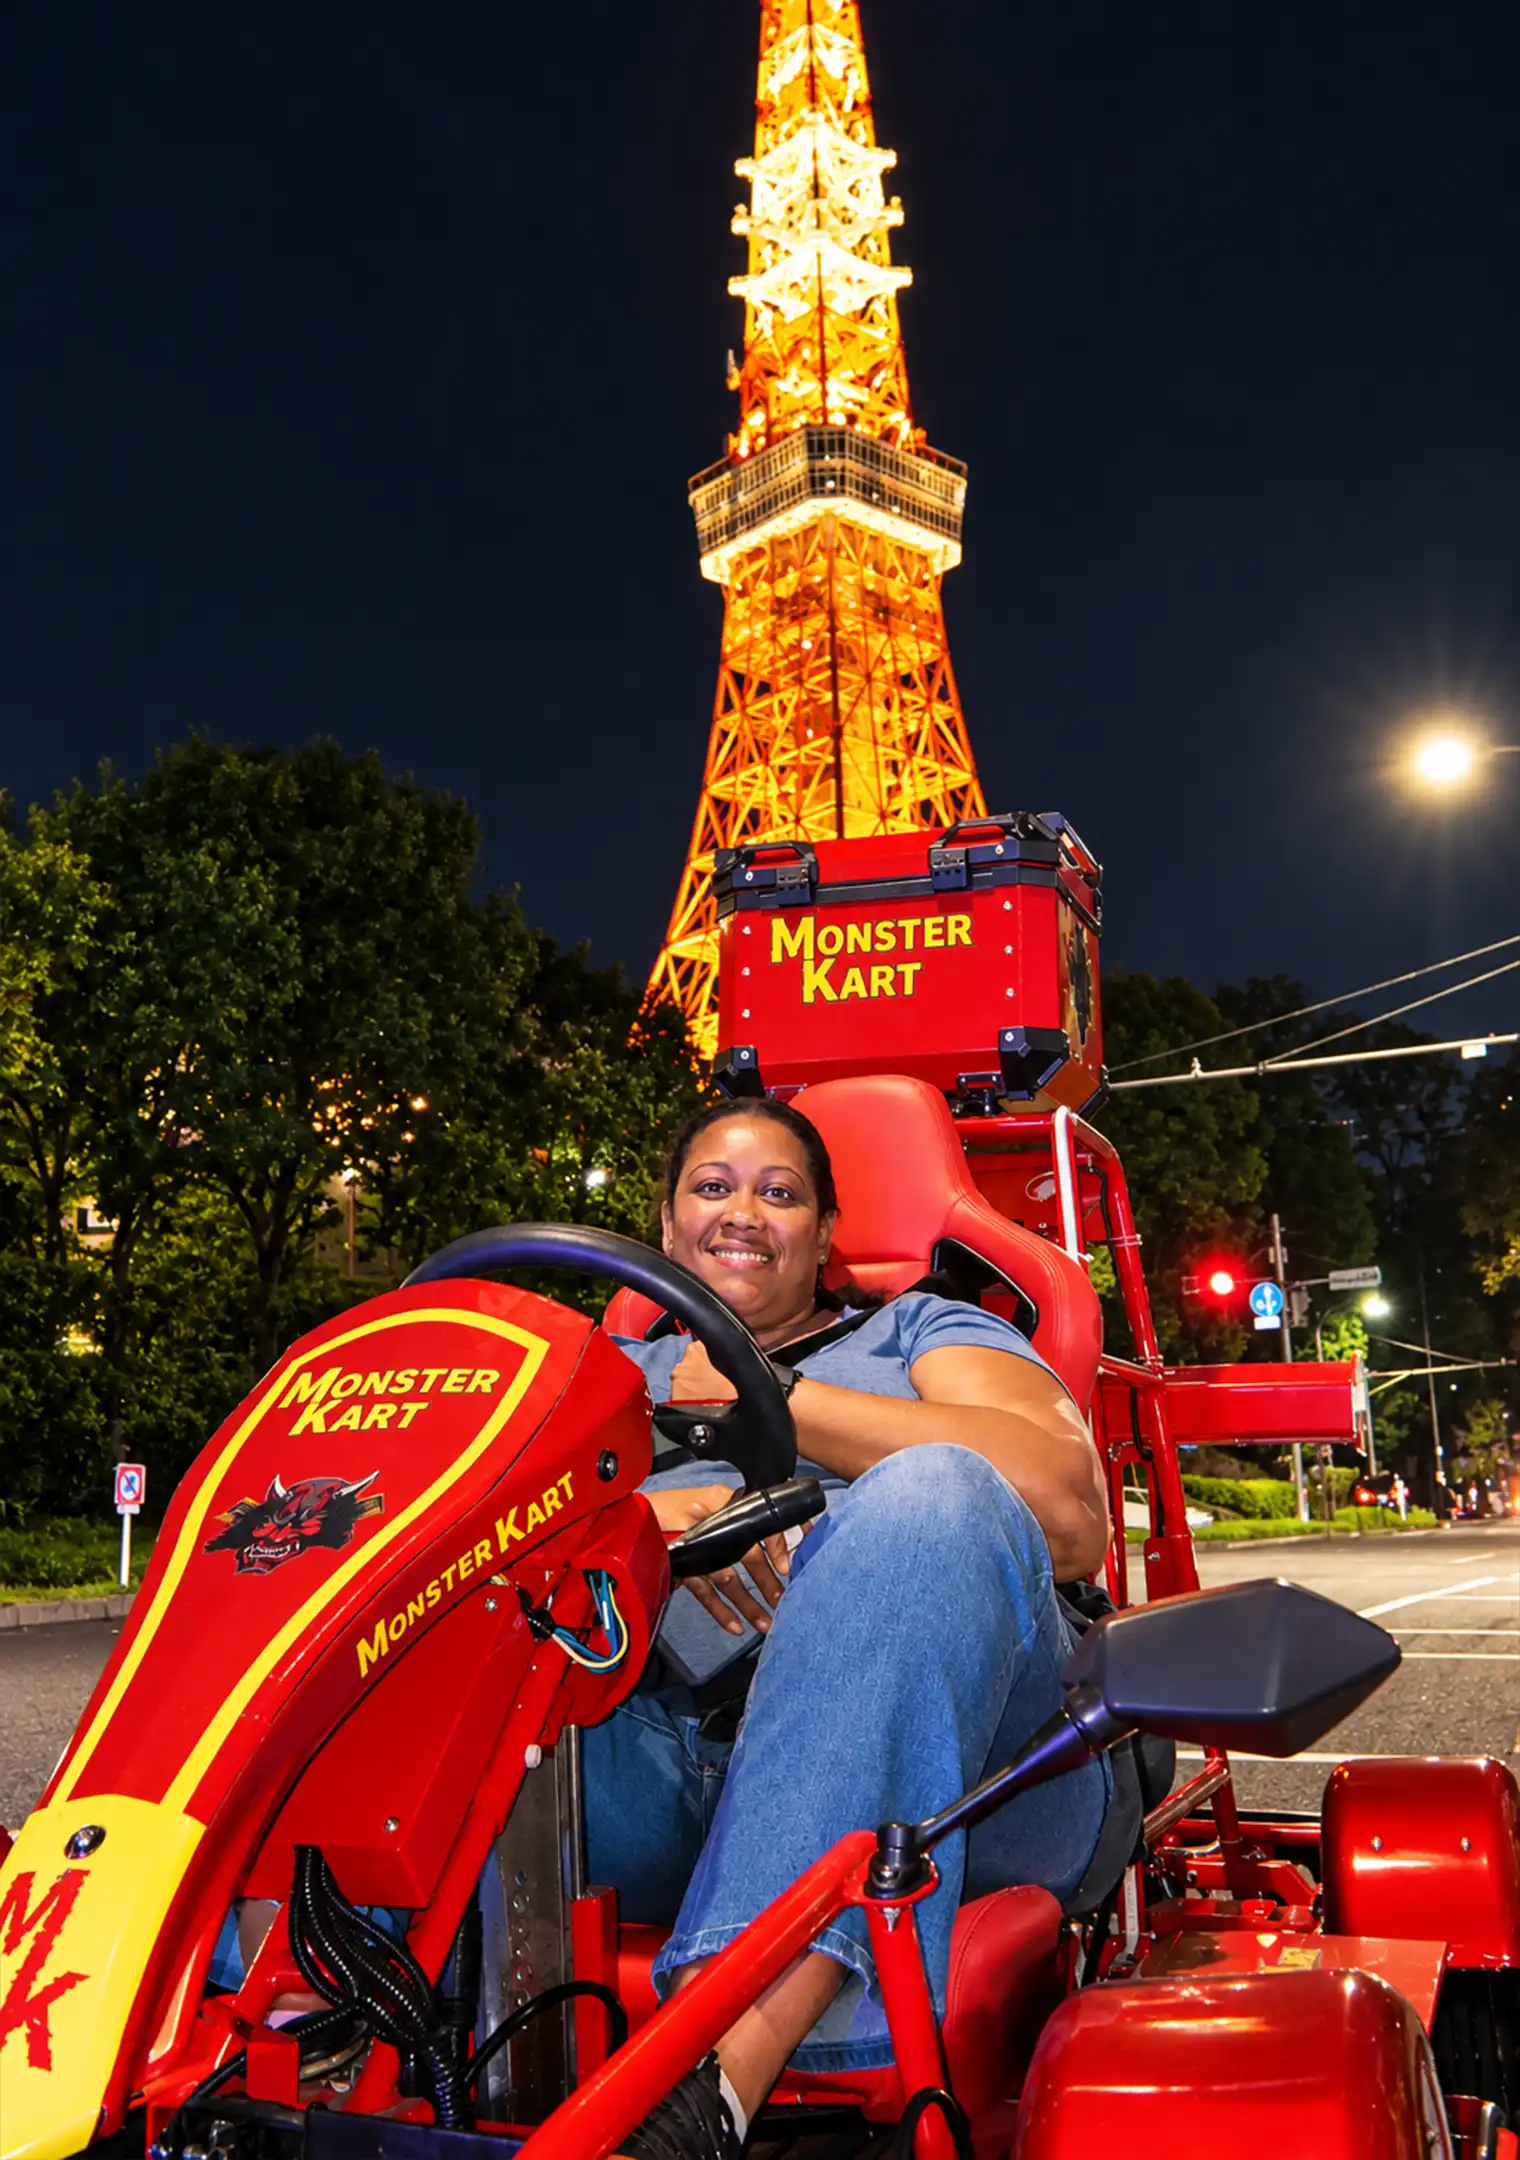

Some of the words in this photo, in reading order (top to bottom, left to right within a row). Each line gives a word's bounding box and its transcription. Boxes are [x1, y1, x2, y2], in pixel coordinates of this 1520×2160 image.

[770, 914, 974, 963] MONSTER
[802, 959, 922, 1004] KART
[278, 1367, 501, 1409] MONSTER
[289, 1399, 429, 1436] KART
[355, 1538, 494, 1679] MONSTER
[494, 1470, 575, 1554] KART
